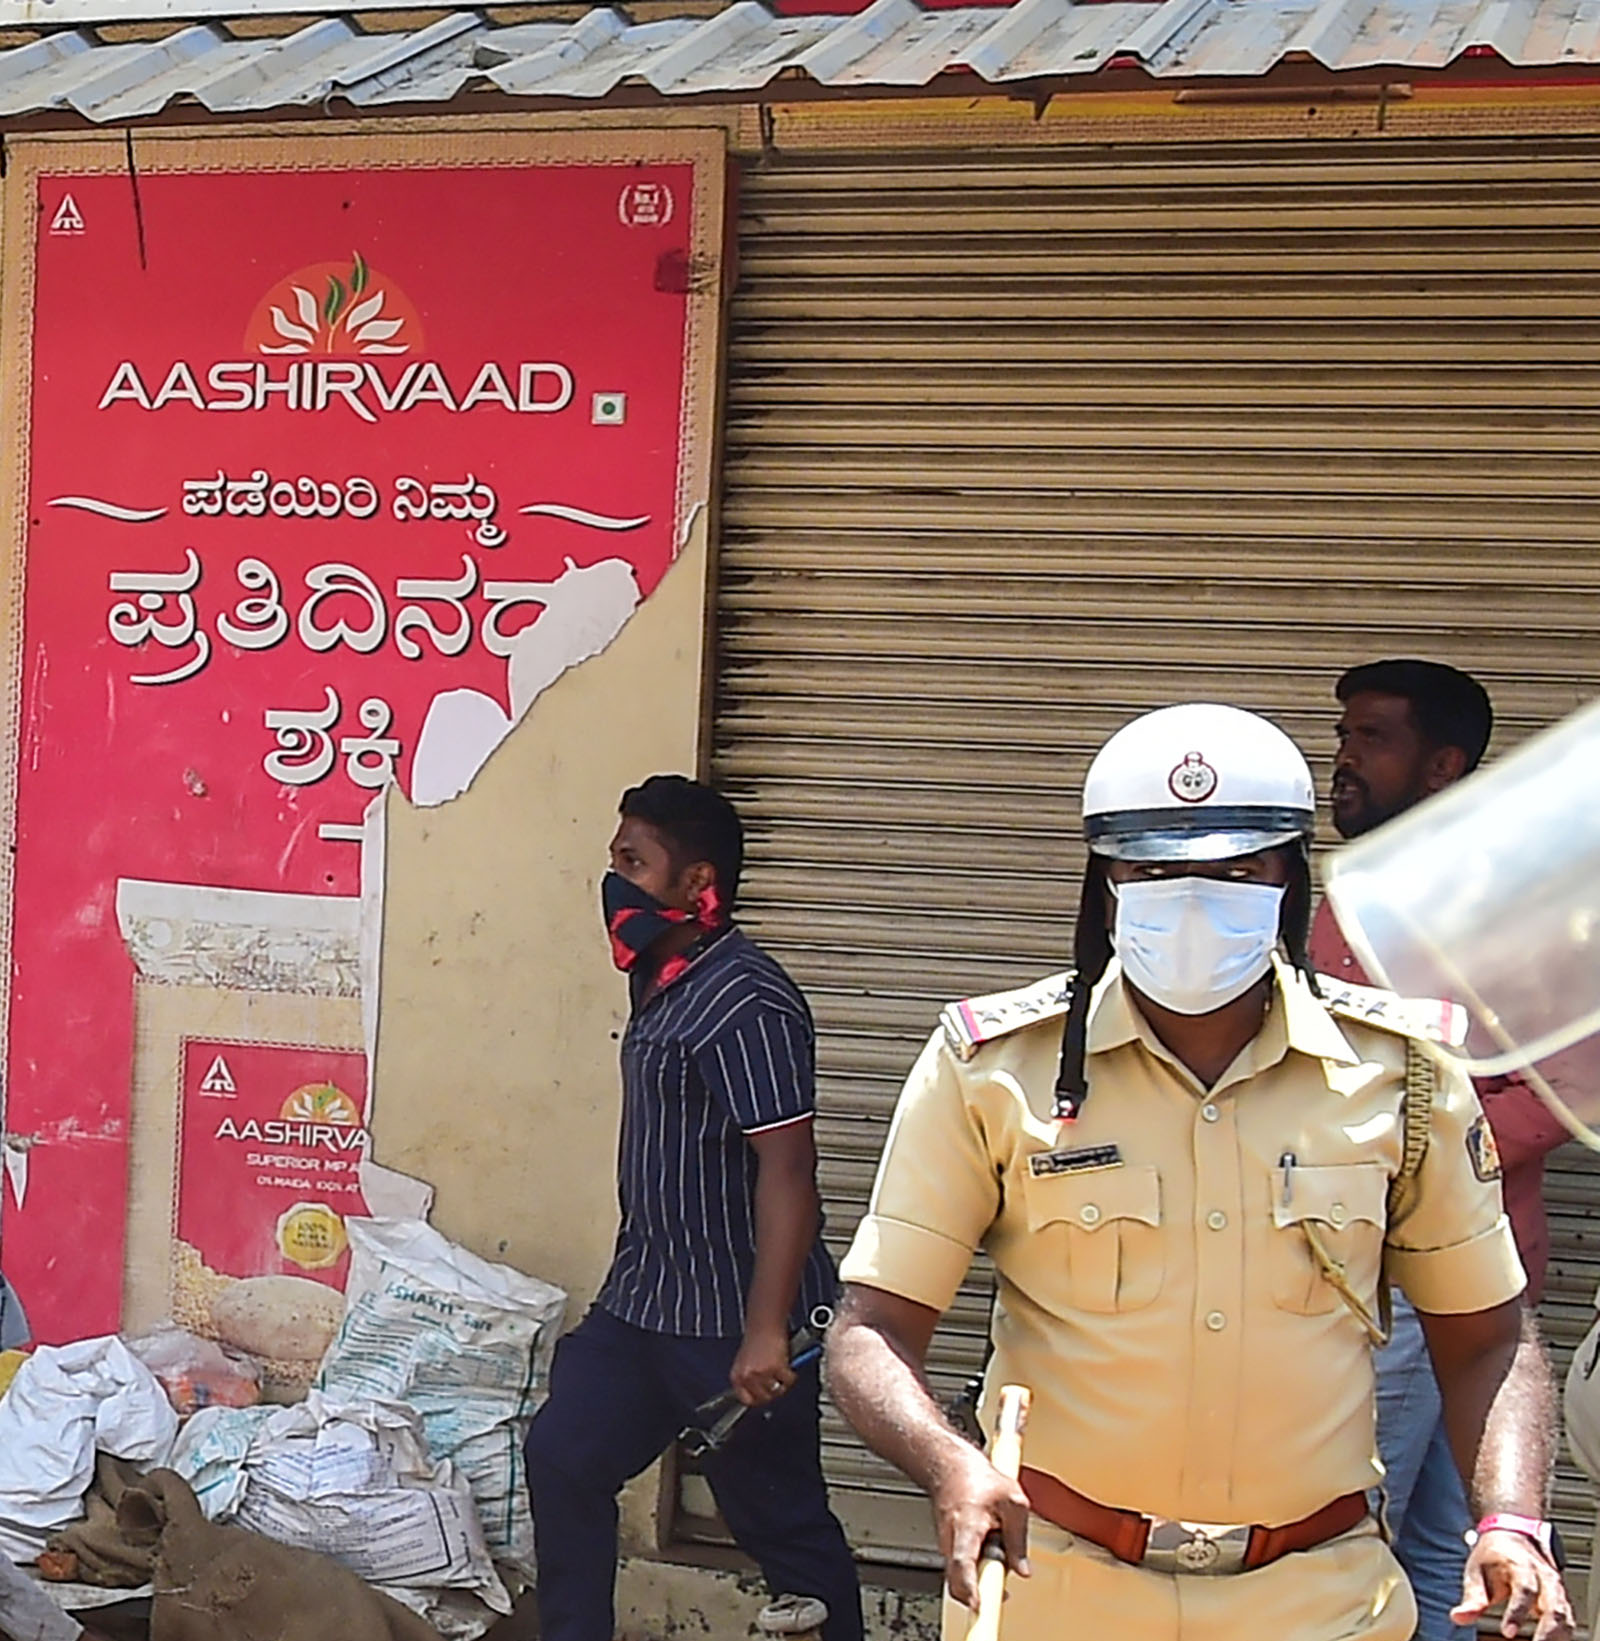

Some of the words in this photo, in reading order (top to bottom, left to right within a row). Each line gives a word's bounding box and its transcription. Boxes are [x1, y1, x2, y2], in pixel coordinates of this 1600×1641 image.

[99, 361, 576, 423] AASHIRVAAD
[181, 470, 379, 520] ಪಡೆಯಿರಿ
[391, 473, 508, 546] ನಿಮ್ಮ
[246, 1153, 320, 1171] SUPERIOR
